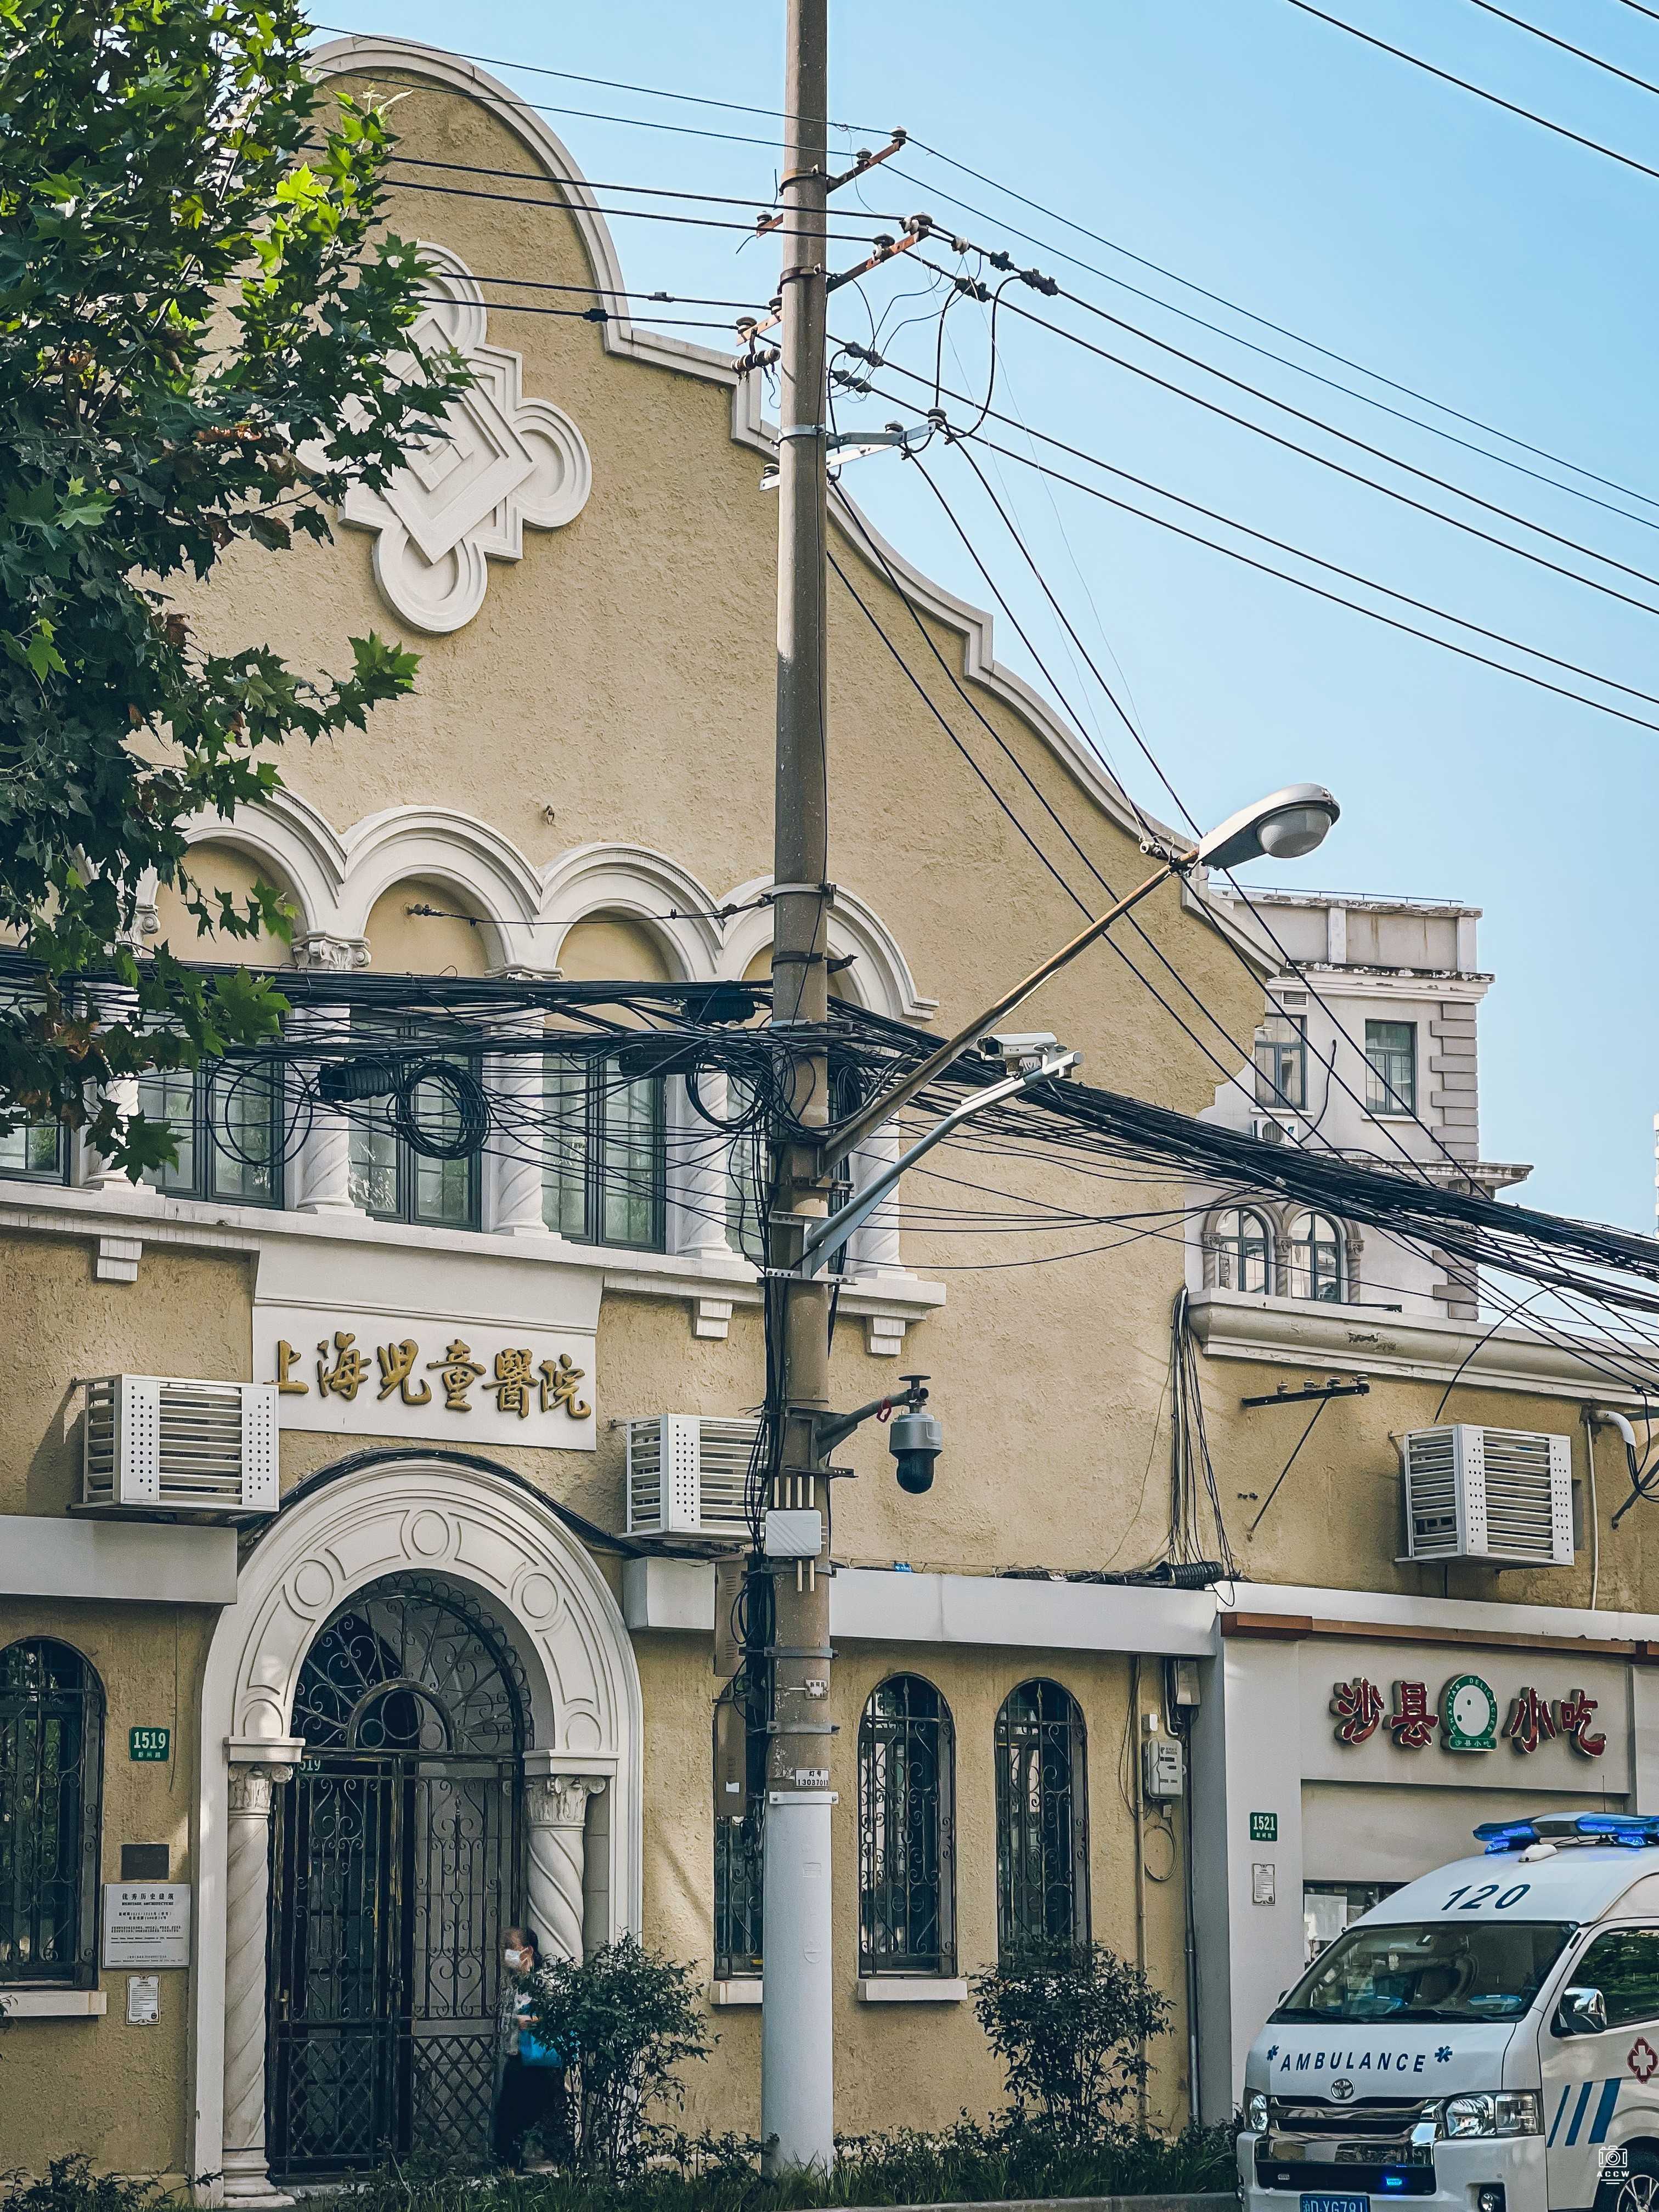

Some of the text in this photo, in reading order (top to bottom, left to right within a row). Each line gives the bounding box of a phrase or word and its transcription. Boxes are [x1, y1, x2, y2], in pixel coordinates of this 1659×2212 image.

[1448, 1678, 1496, 1733] SHAXIAN DELICACIES
[134, 1731, 166, 1749] 1519
[1253, 1816, 1276, 1831] 1521
[1441, 1884, 1531, 1911] 120
[1280, 2052, 1426, 2073] AMBULANCE
